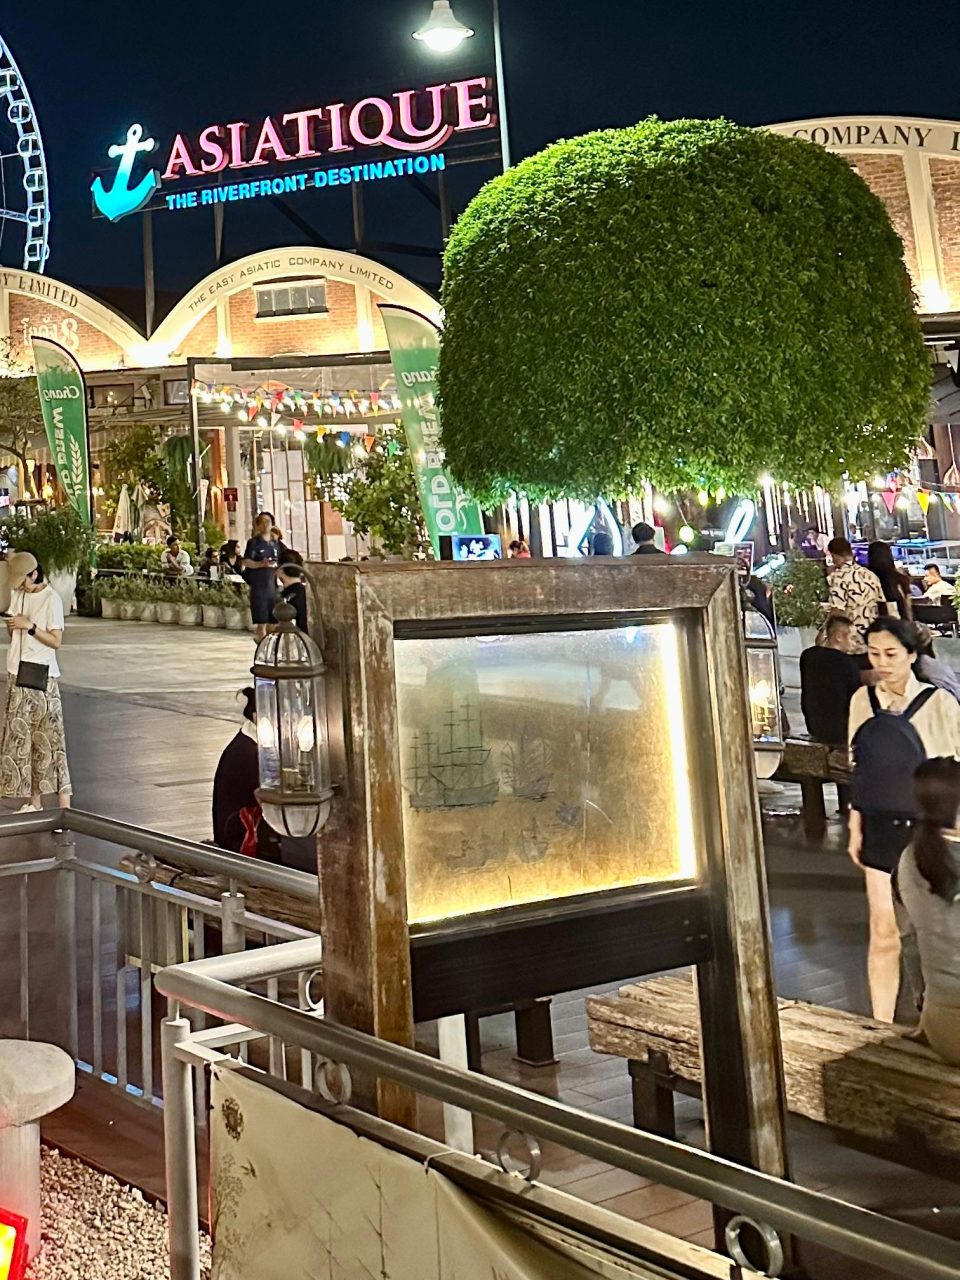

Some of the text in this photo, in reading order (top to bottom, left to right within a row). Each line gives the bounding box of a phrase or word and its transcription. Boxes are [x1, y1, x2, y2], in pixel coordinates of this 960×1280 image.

[162, 77, 495, 179] ASIATIQUE
[166, 153, 446, 210] THE RIVERFRONT DESTINATION
[19, 277, 79, 309] LIMITED
[188, 257, 395, 312] THE EAST ASIATIC COMPANY LIMITED
